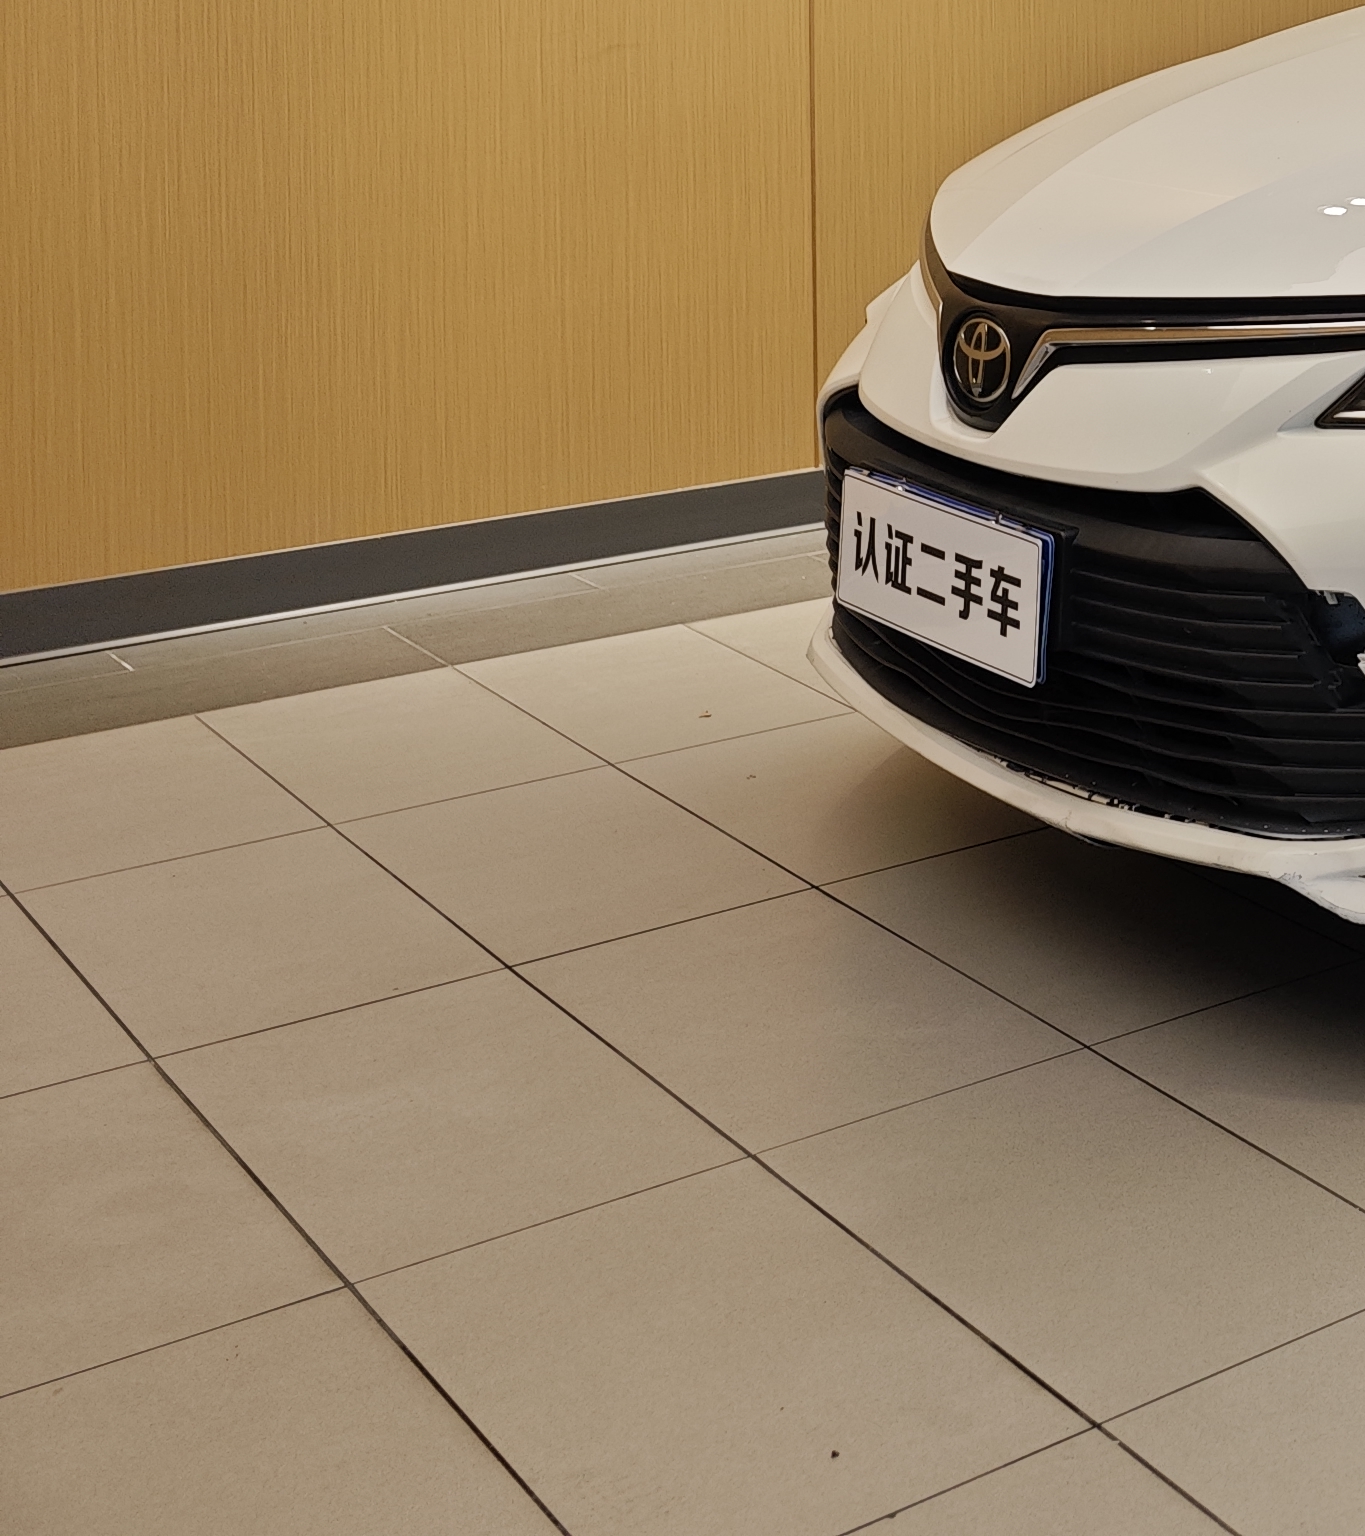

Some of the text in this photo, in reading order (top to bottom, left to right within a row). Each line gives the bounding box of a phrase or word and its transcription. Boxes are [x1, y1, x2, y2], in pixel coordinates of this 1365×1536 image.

[854, 511, 1021, 637] 认证二手车
